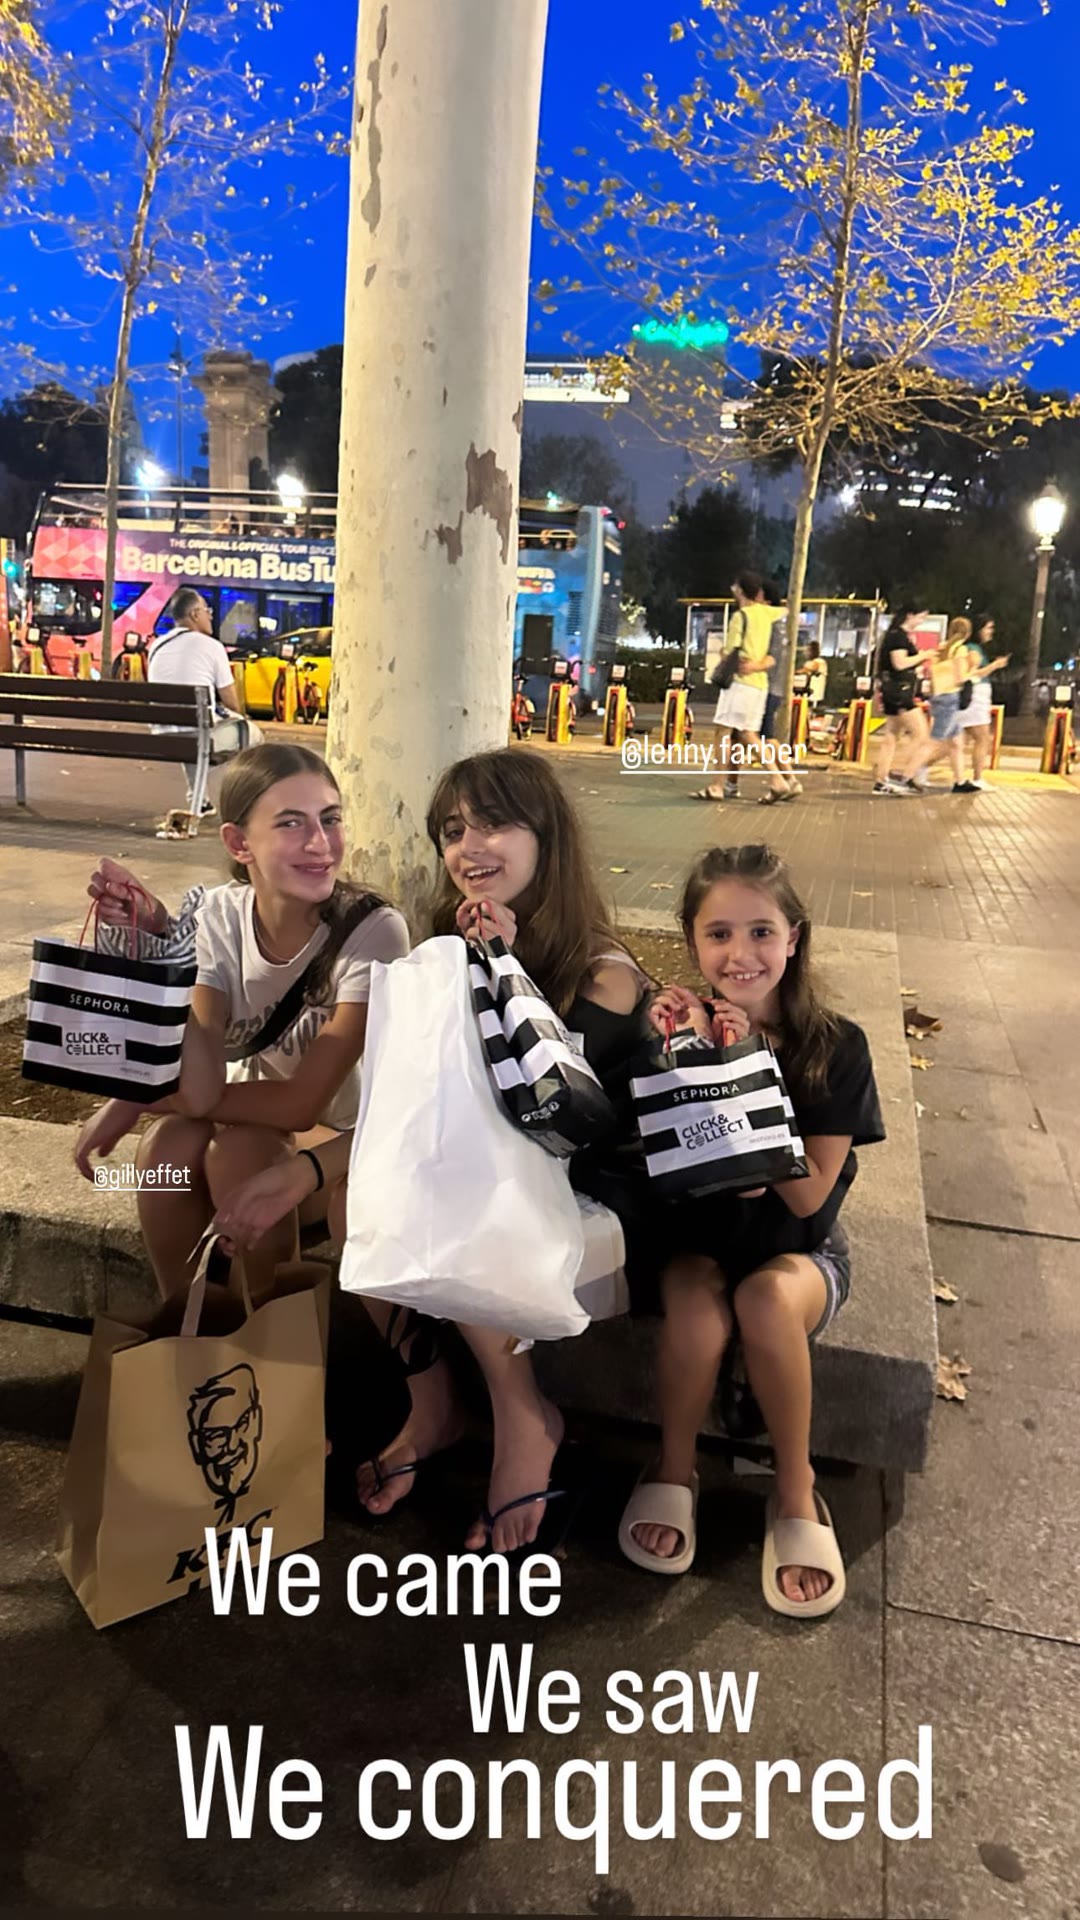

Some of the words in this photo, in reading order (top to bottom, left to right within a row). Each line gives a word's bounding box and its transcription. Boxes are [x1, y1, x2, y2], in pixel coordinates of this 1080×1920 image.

[281, 543, 307, 554] TOUR
[122, 546, 258, 579] Barcelona
[69, 993, 130, 1014] SEPHORA
[65, 1044, 122, 1056] COLLECT
[673, 1083, 740, 1102] SEPHORA
[686, 1119, 744, 1151] COLLECT
